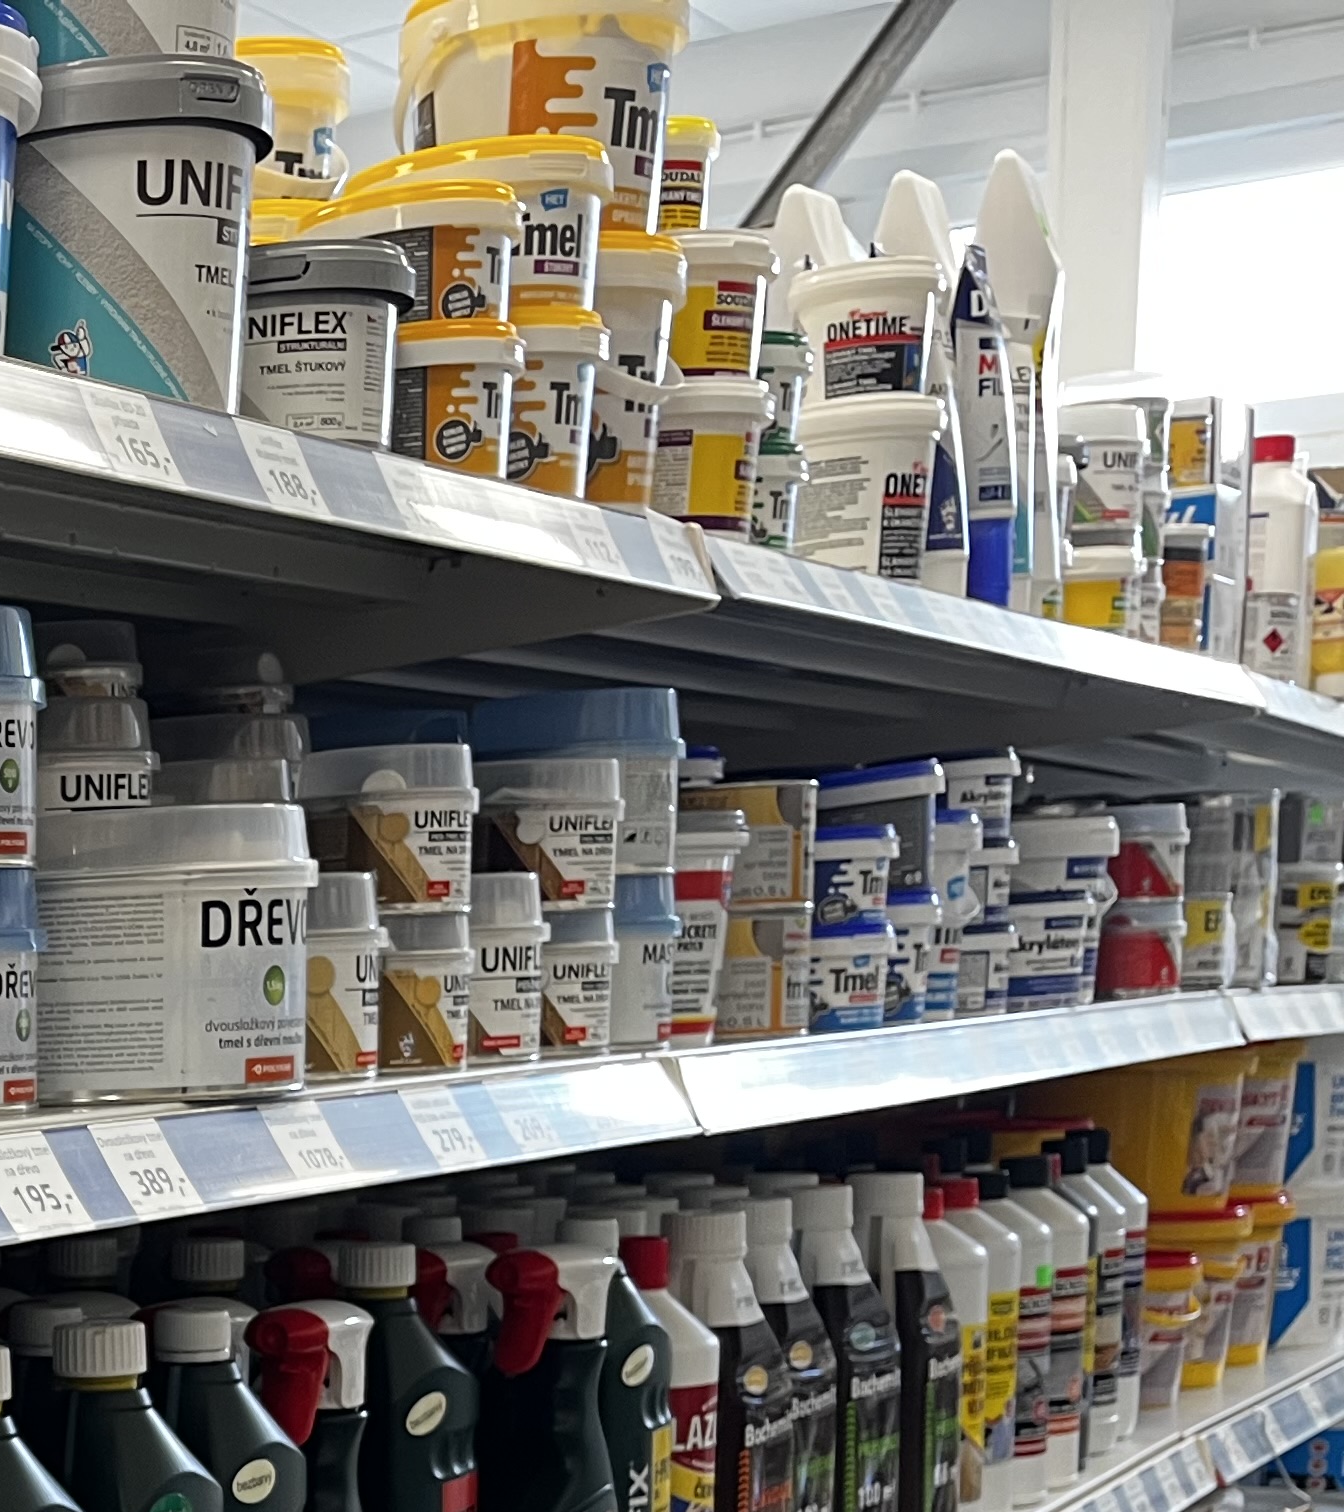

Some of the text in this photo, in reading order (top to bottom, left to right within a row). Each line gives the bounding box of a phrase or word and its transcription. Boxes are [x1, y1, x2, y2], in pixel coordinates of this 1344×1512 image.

[136, 159, 243, 212] UNIF
[248, 311, 348, 339] NIFLEX
[826, 316, 910, 342] ONETIME
[114, 431, 171, 476] 165,-
[830, 964, 880, 996] Tmel
[433, 1126, 476, 1154] 279,-
[298, 1148, 345, 1171] 1078,-
[135, 1166, 187, 1197] 389,-
[13, 1184, 74, 1215] 195,-
